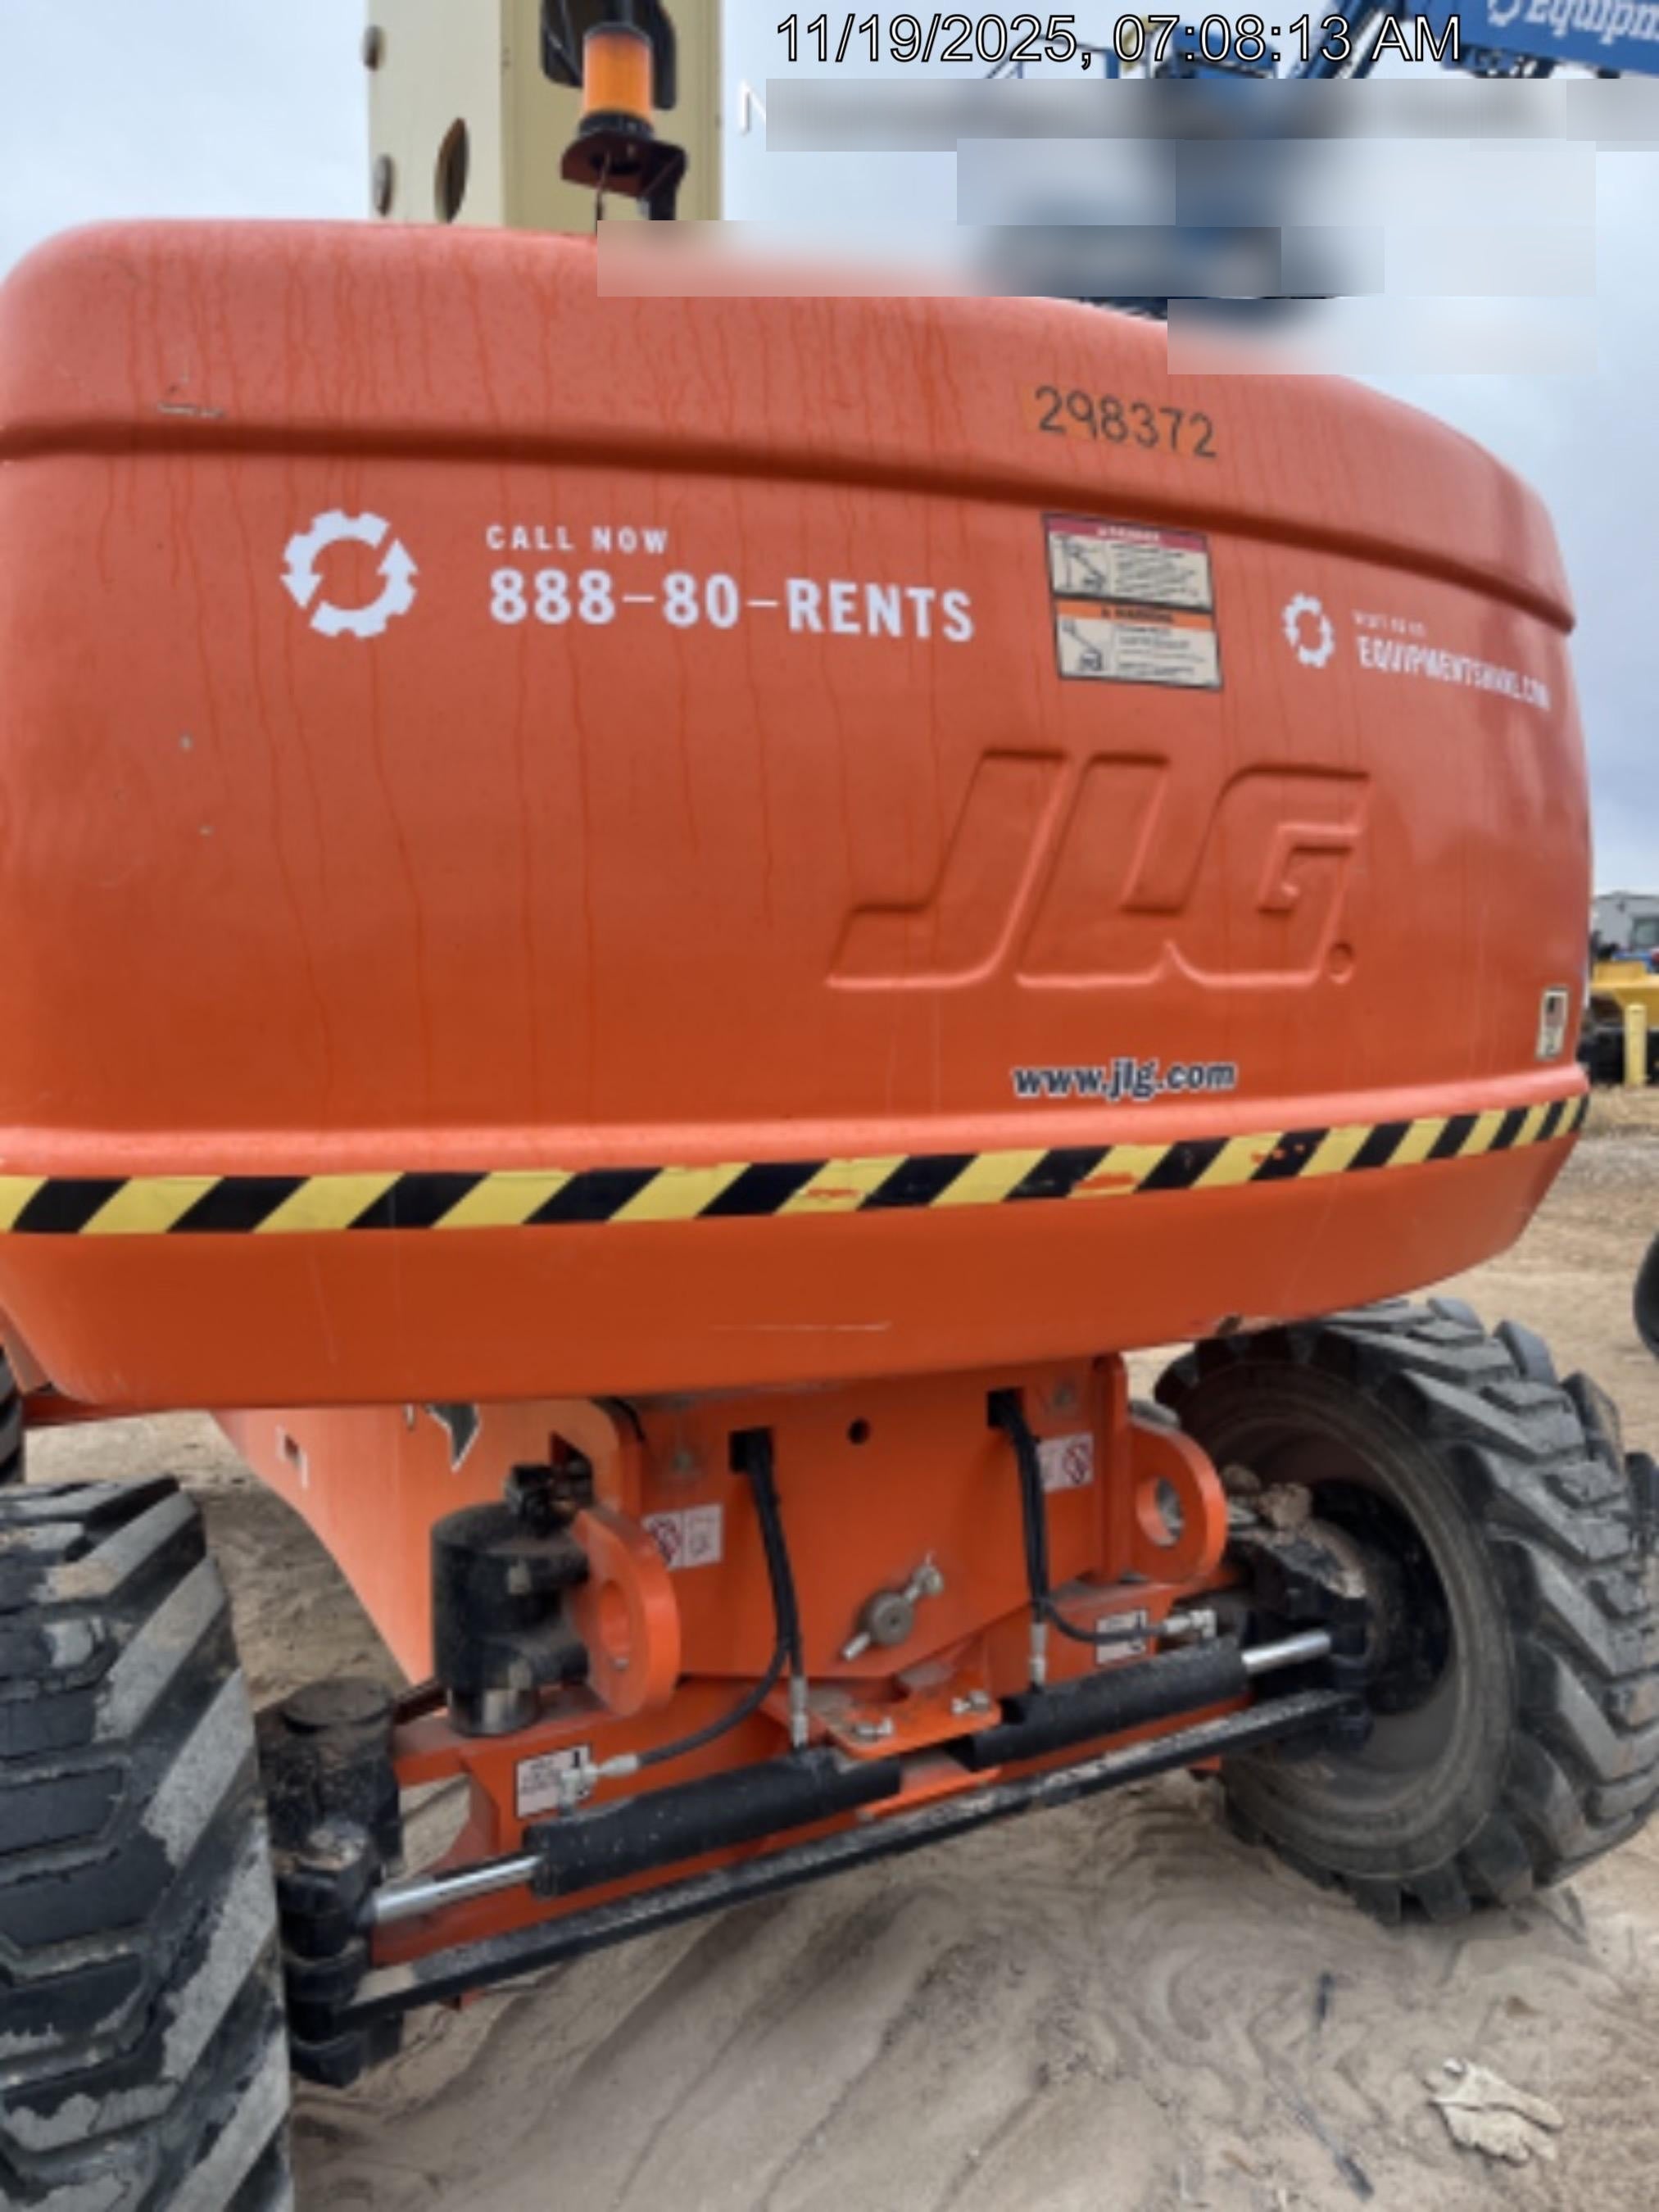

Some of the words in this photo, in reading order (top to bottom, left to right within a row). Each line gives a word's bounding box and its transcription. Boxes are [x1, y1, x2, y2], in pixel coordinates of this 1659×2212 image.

[1035, 385, 1217, 458] 298372
[485, 524, 574, 551] CALL
[592, 527, 669, 554] NOW
[490, 567, 975, 643] 888-80-RENTS
[1012, 1057, 1238, 1101] www.jlg.com
